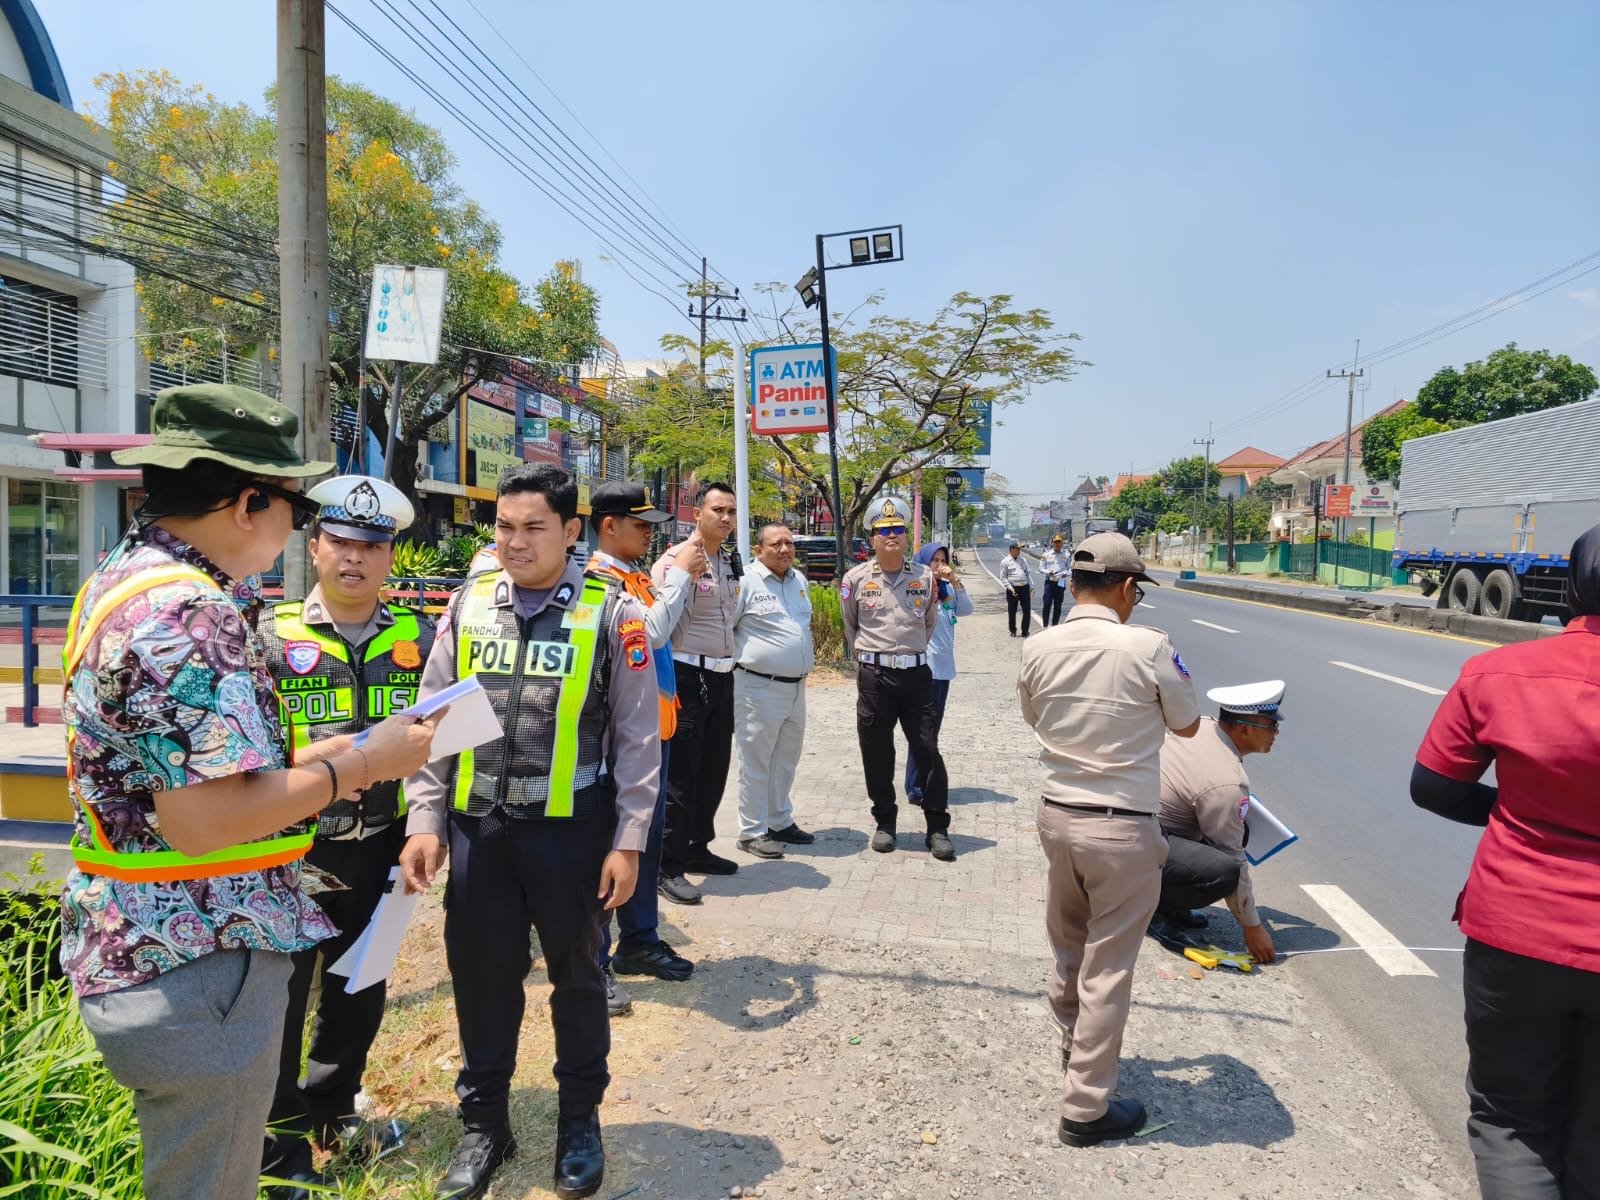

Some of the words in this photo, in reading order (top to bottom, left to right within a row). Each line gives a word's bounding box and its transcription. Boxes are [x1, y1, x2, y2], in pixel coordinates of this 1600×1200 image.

[780, 359, 825, 380] ATM
[759, 381, 826, 404] Panin
[462, 624, 499, 636] PANDHU
[468, 640, 513, 671] POL
[529, 644, 575, 675] ISI
[286, 678, 323, 688] FIAN
[282, 690, 350, 723] POL
[374, 687, 419, 715] IS
